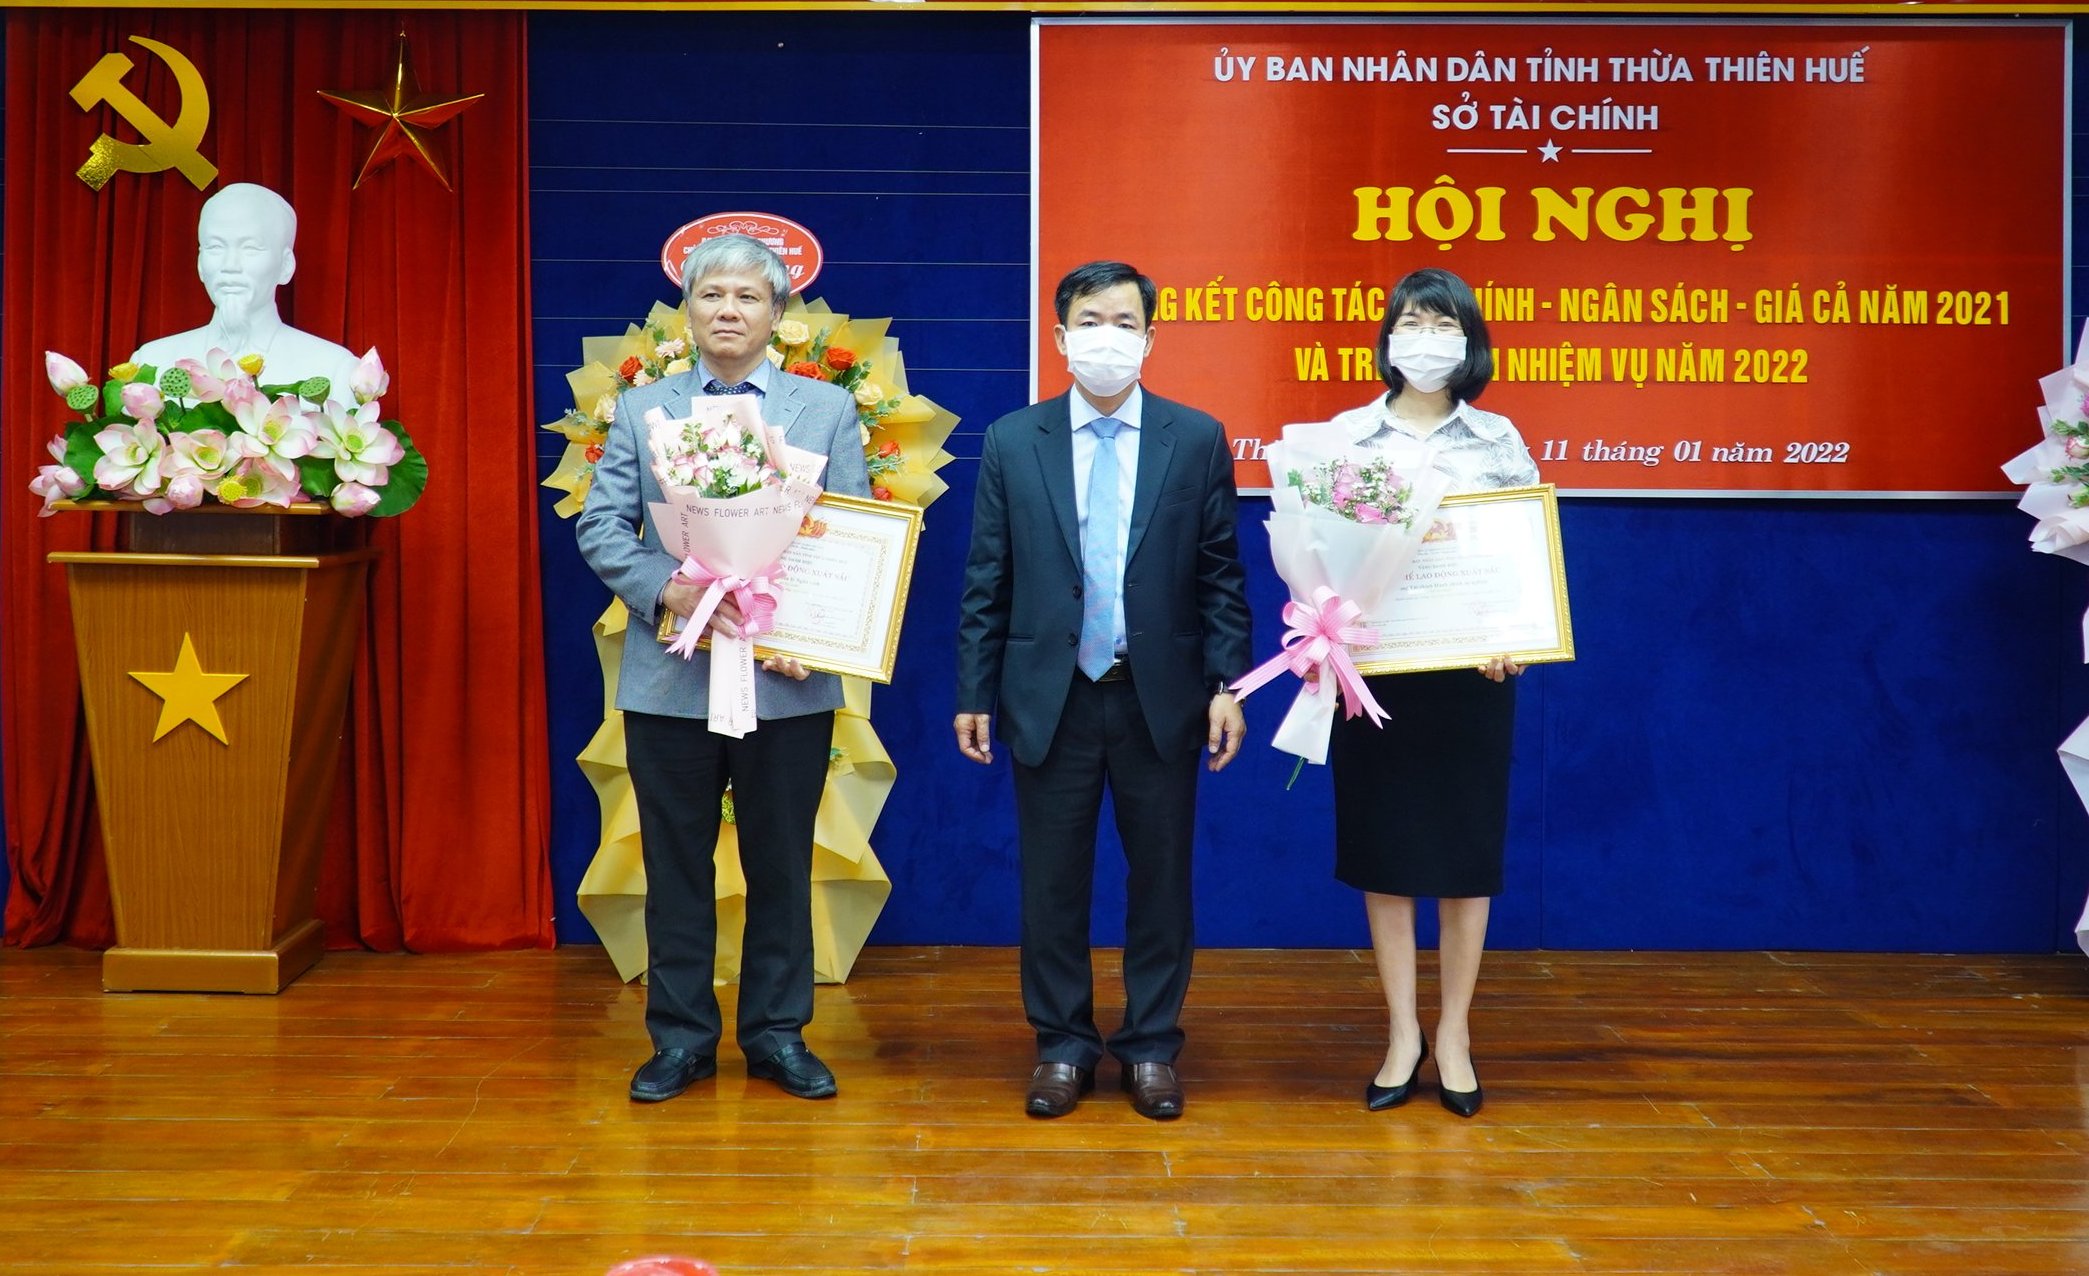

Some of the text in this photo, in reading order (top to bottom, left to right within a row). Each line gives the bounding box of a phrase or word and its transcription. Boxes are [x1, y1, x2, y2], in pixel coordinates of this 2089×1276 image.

[1214, 46, 1870, 83] ỦY BAN NHÂN DÂN TỈNH THỪA THIÊN HUẾ
[1432, 91, 1658, 131] SỞ TÀI CHÍNH
[1352, 174, 1754, 252] HỘI NGHỊ
[1185, 275, 1239, 322] KẾT
[1246, 280, 1324, 322] CÔNG
[1331, 281, 1385, 322] TÁC
[1541, 301, 1552, 309] -
[1559, 282, 1643, 323] NGÂN
[1650, 282, 1729, 324] SÁCH
[1736, 302, 1747, 310] -
[1754, 283, 1804, 324] GIÁ
[1812, 280, 1851, 324] CẢ
[1859, 284, 1928, 324] NĂM
[1936, 291, 2010, 325] 2021
[1294, 341, 1330, 381] VÀ
[1338, 347, 1383, 381] TR
[1507, 341, 1602, 388] NHIỆM
[1610, 348, 1649, 388] VỤ
[1656, 342, 1725, 383] NĂM
[1733, 349, 1809, 384] 2022
[1232, 438, 1850, 467] Th 11 tháng 01 năm 2022
[680, 512, 689, 529] ART
[686, 504, 710, 517] NEWS
[714, 508, 749, 518] FLOWER
[754, 507, 769, 517] ART
[740, 646, 749, 712] NEWS FLOWER
